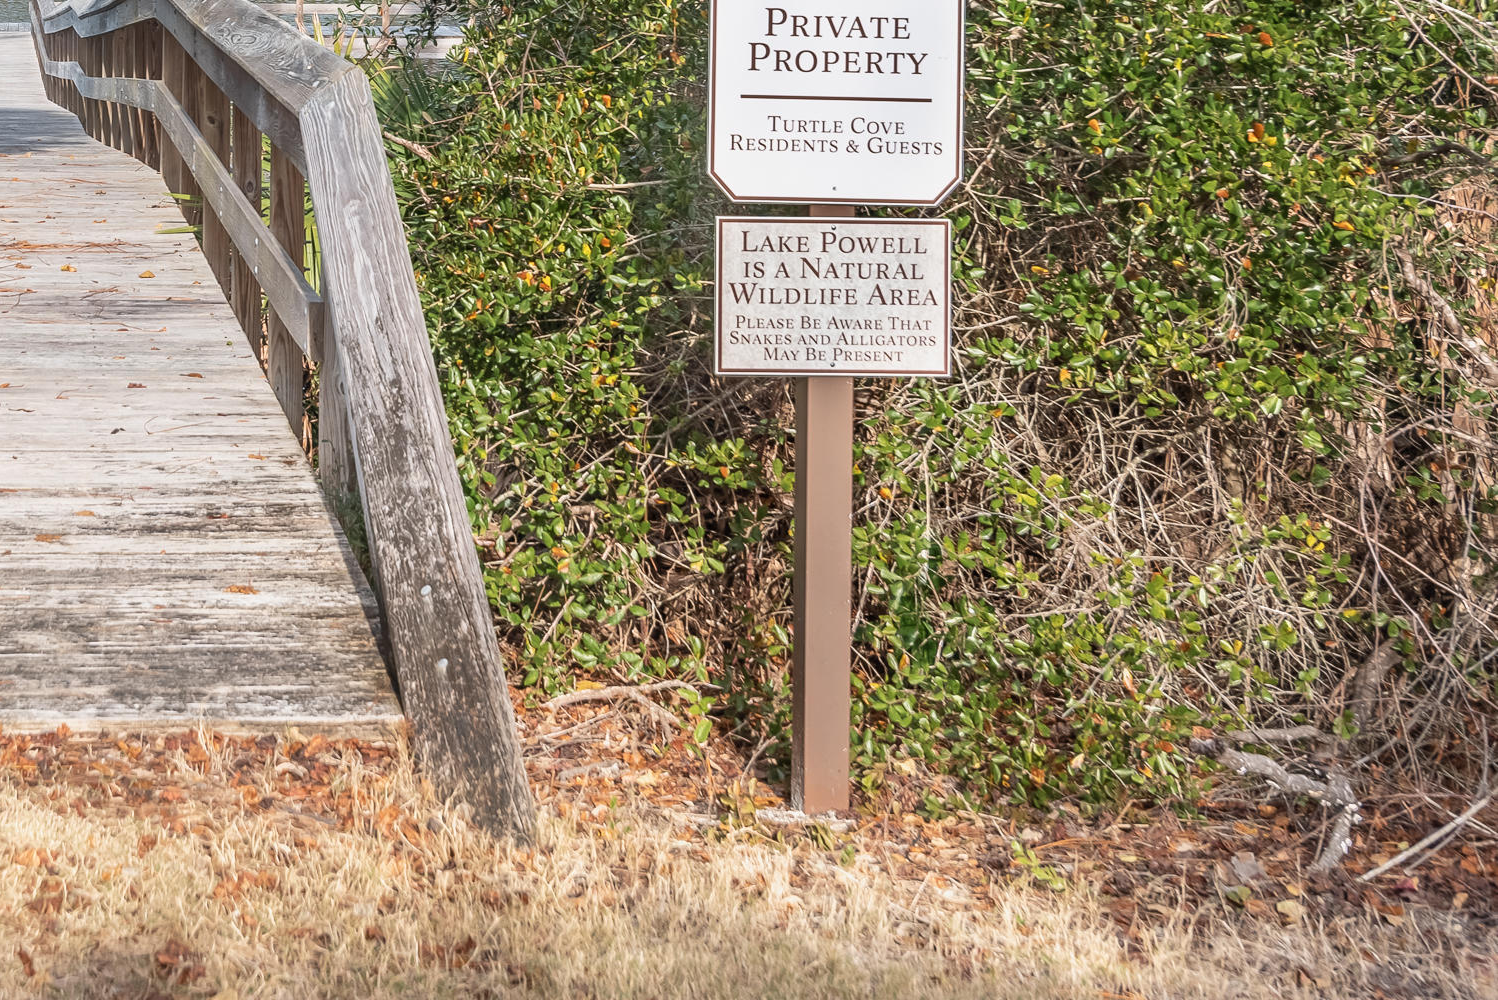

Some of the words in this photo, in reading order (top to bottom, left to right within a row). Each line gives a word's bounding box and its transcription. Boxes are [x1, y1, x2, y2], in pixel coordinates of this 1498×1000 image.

[765, 8, 910, 39] PRIVATE
[748, 43, 928, 74] PROPERTY
[768, 116, 843, 133] TURTLE
[851, 117, 904, 134] COVE
[730, 134, 838, 153] RESIDENTS
[846, 140, 859, 154] &
[867, 137, 942, 155] GUESTS
[742, 231, 810, 252] LAKE
[821, 232, 927, 254] POWELL
[743, 262, 764, 278] IS
[775, 262, 790, 278] A
[801, 258, 924, 280] NATURAL
[729, 283, 858, 305] WILDLIFE
[866, 284, 938, 306] AREA
[736, 315, 794, 329] PLEASE
[801, 316, 821, 330] BE
[827, 316, 882, 330] AWARE
[888, 317, 932, 331] THAT
[730, 331, 791, 345] SNAKES
[798, 335, 830, 345] AND
[836, 333, 936, 346] ALLIGATORS
[764, 348, 799, 361] MAY
[806, 348, 826, 361] BE
[833, 348, 904, 362] PRESENT
